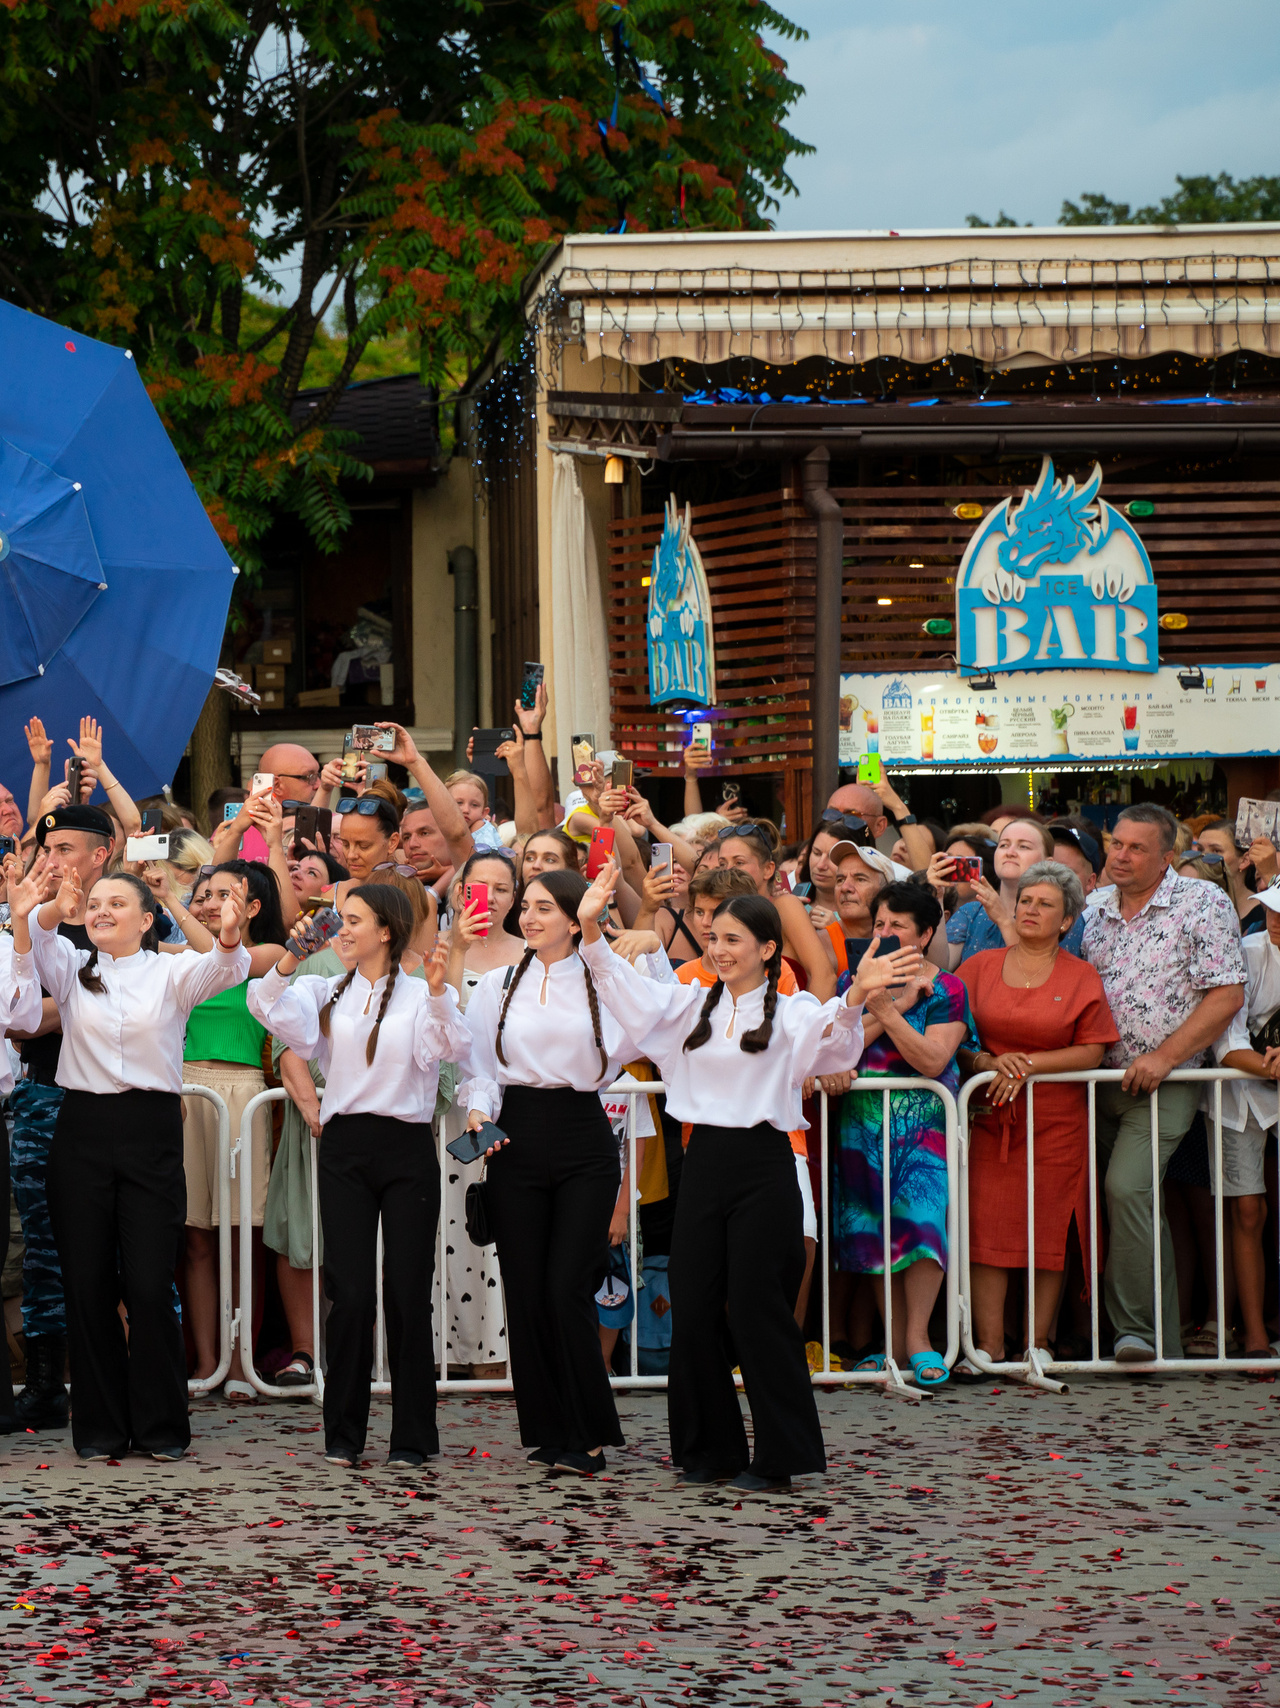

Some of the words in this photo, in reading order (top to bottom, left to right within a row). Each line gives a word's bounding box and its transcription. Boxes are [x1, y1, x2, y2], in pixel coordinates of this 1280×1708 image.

[1046, 581, 1078, 595] ICE
[970, 604, 1150, 667] BAR
[650, 639, 705, 698] BAR
[883, 698, 912, 709] BAR
[918, 695, 1047, 705] АЛКОГОЛЬНЫЕ
[1063, 693, 1153, 702] КОКТЕЙЛИ
